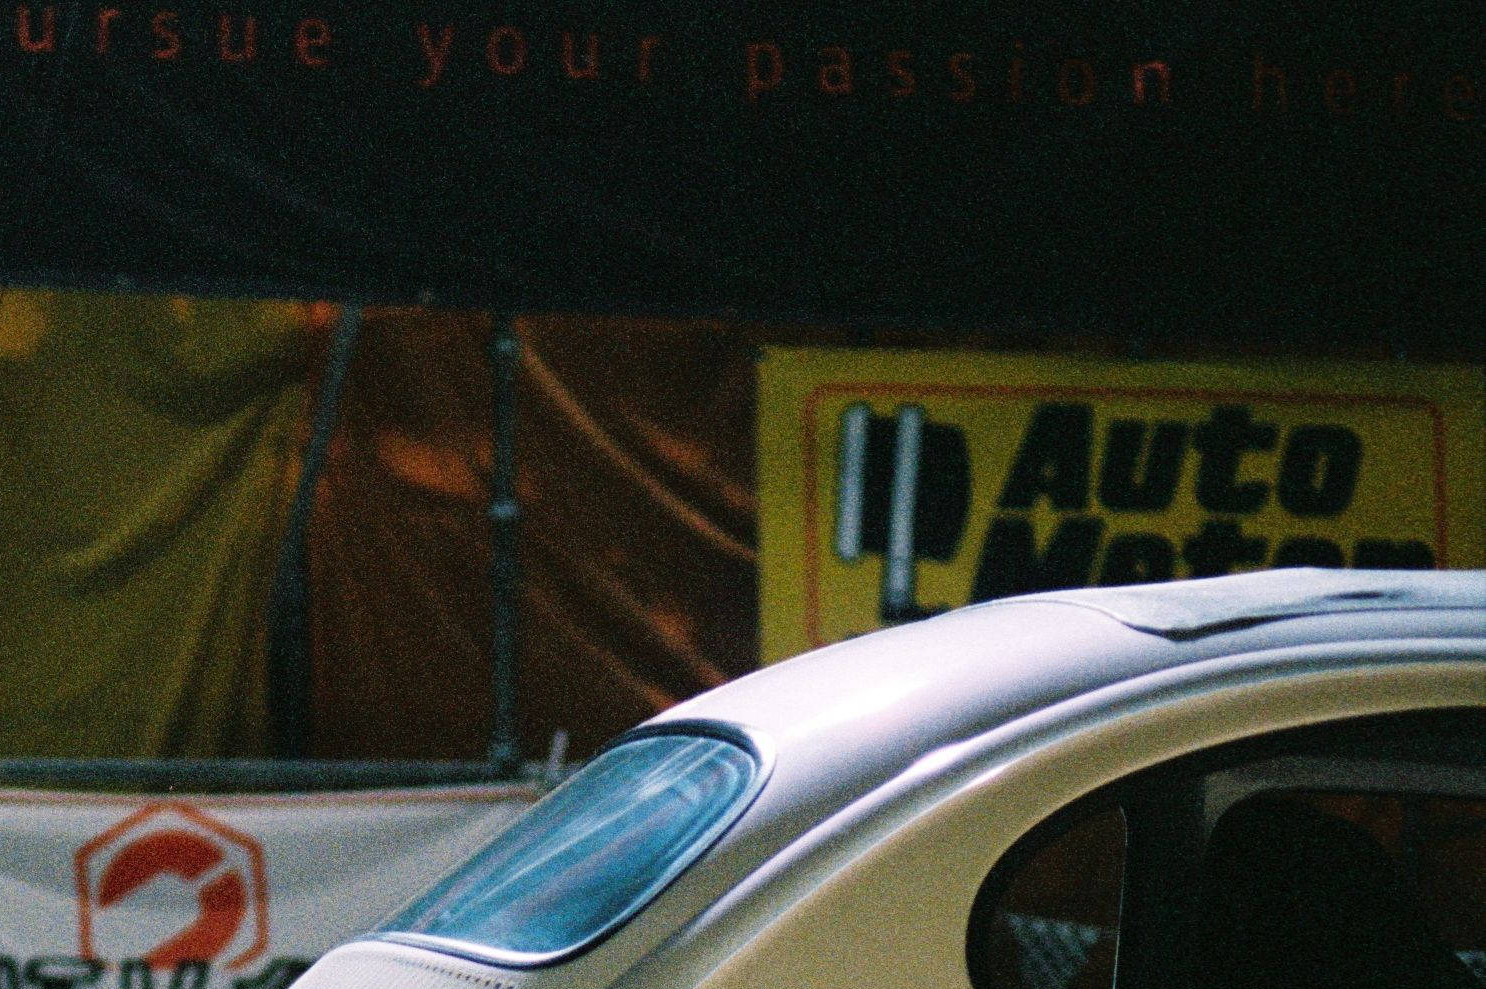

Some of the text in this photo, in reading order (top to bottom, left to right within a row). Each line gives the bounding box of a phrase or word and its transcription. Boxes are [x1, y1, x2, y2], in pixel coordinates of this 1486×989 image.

[416, 24, 660, 87] your
[744, 40, 1171, 104] passion
[1252, 52, 1476, 121] here
[997, 403, 1364, 517] Auto
